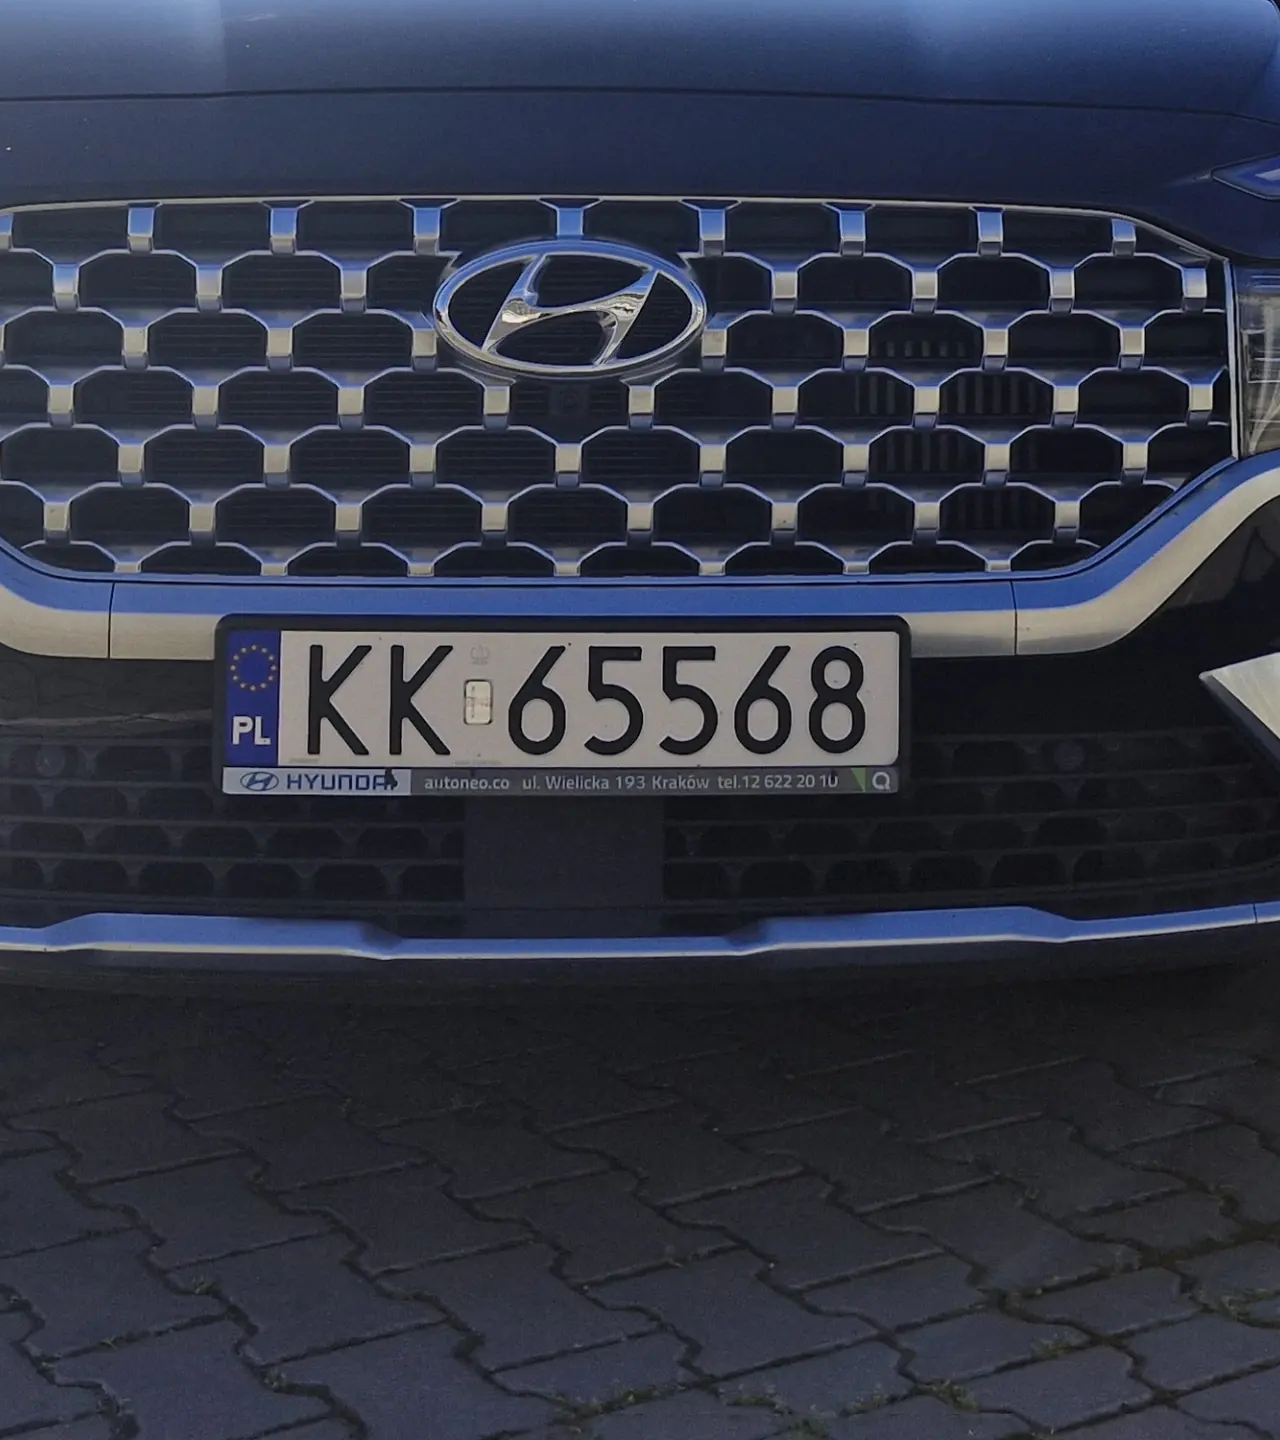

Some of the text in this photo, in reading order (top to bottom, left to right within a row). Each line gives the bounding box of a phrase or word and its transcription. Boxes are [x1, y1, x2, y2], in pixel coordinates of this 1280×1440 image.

[307, 644, 867, 756] KK 65568
[231, 715, 271, 745] PL
[286, 772, 399, 791] HYUNDA
[424, 775, 510, 791] autoneo.co
[523, 775, 540, 791] ul.
[545, 775, 610, 791] Wielicka
[616, 775, 646, 790] 193
[652, 774, 710, 790] Kraków
[764, 774, 793, 789] 622
[796, 774, 816, 789] 20
